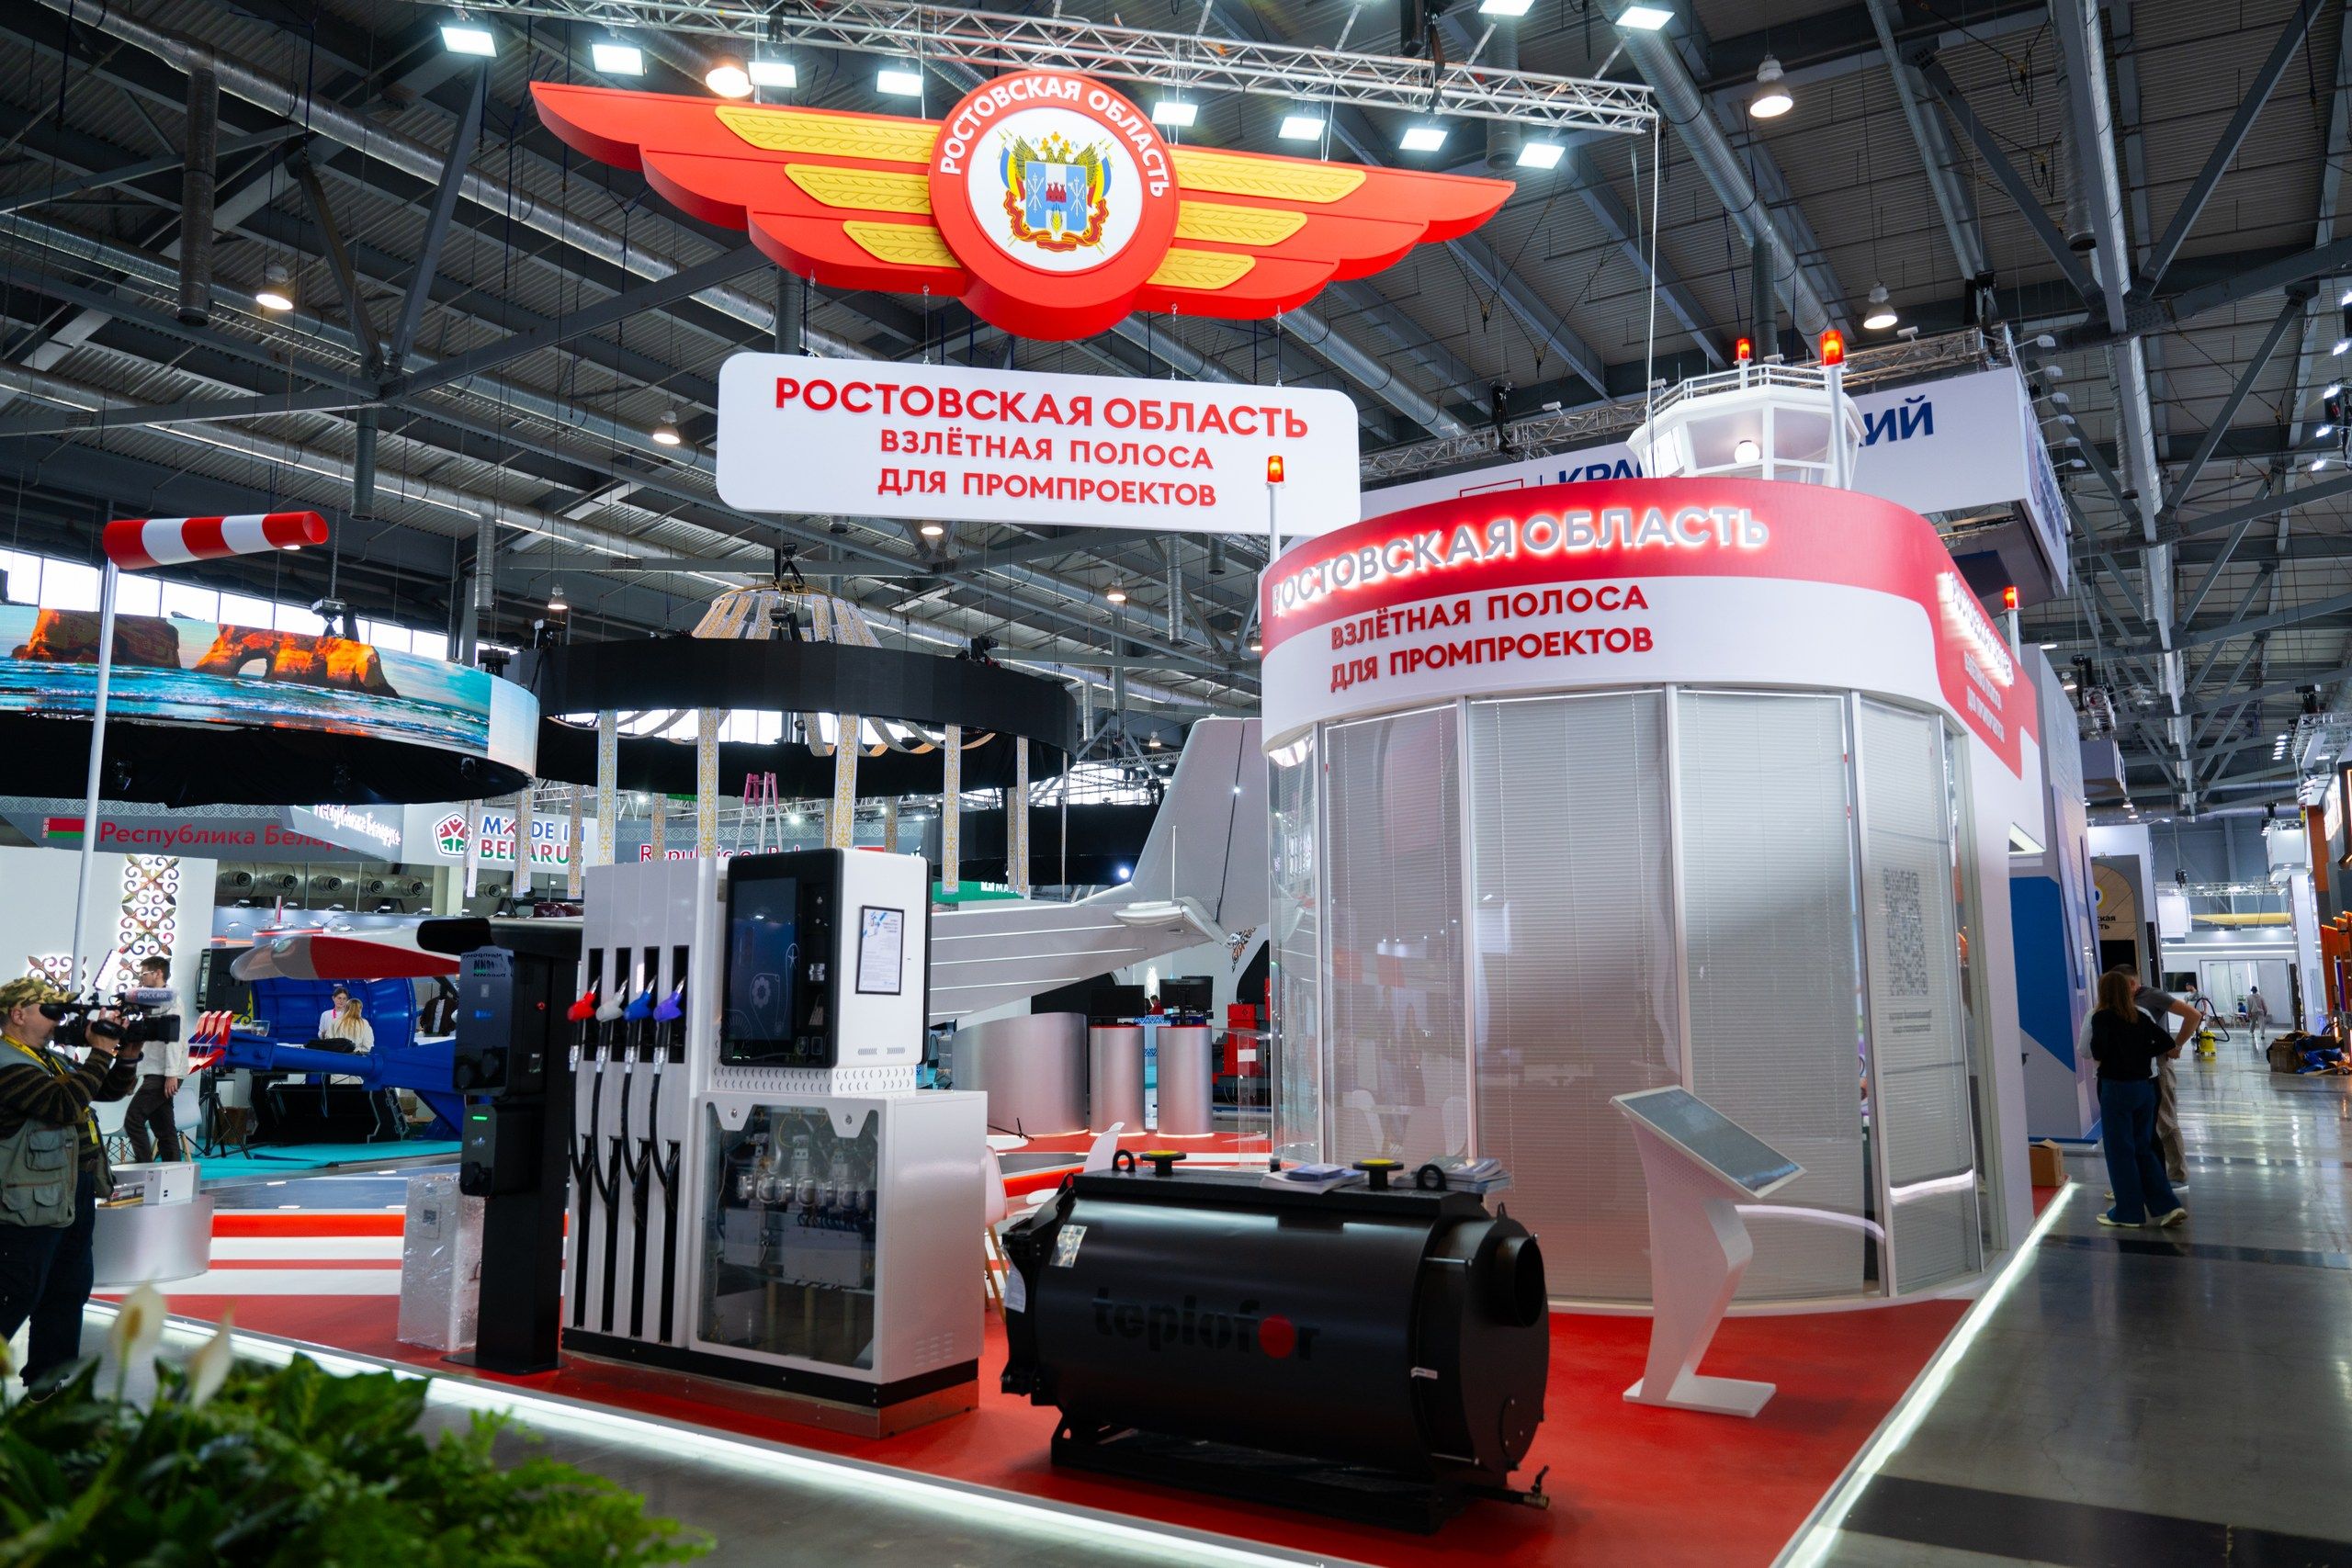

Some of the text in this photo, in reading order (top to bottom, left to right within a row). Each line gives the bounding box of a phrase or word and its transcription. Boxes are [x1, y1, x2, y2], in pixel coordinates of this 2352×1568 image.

[939, 76, 1170, 198] РОСТОВСКАЯ ОБЛАСТЬ
[775, 378, 1308, 439] РОСТОВСКАЯ ОБЛАСТЬ
[880, 426, 1214, 470] ВЗЛЁТНАЯ ПОЛОСА
[877, 468, 1216, 508] ДЛЯ ПРОМПРОЕКТОВ
[1272, 506, 1770, 618] РОСТОВСКАЯ ОБЛАСТЬ
[1330, 584, 1650, 651] ВЗЛЁТНАЯ ПОЛОСА
[1330, 626, 1654, 694] ДЛЯ ПРОМПРОЕКТОВ
[99, 820, 255, 850] Республика
